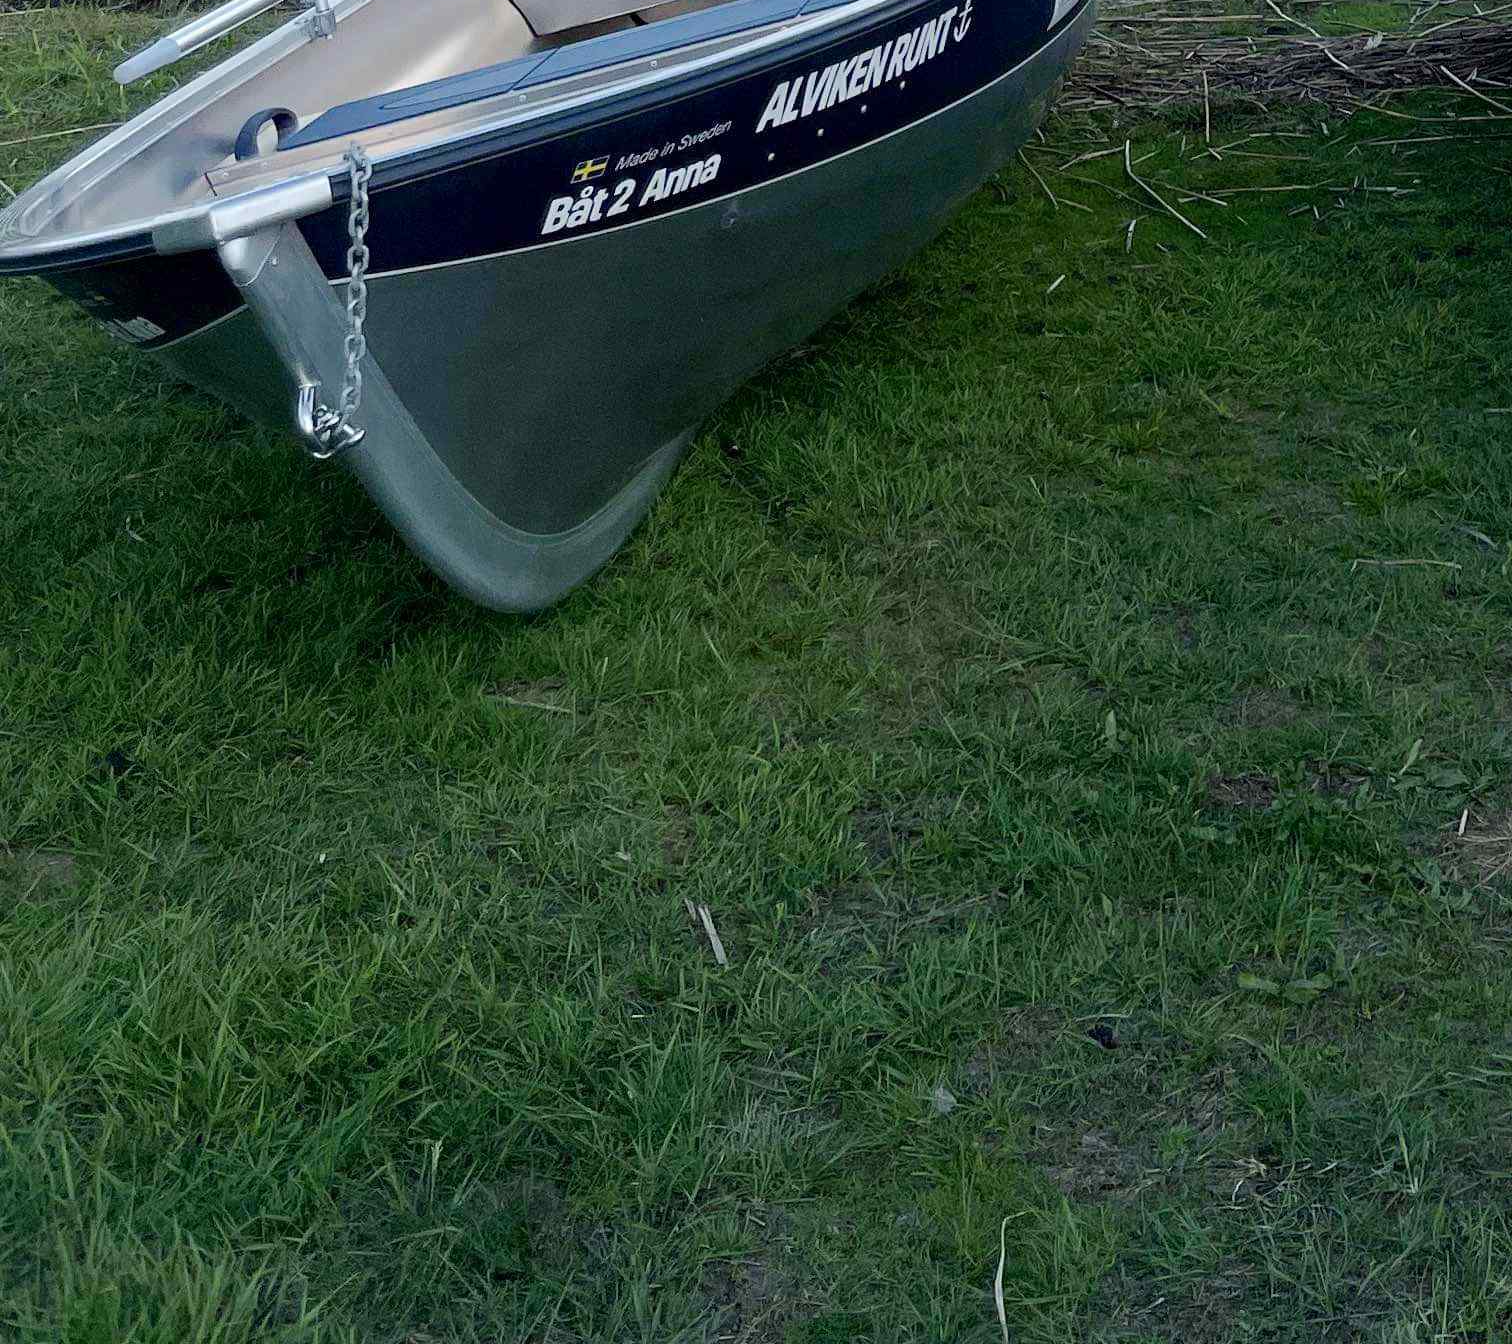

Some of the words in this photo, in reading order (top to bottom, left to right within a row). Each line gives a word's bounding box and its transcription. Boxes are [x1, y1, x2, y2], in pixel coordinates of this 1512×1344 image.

[755, 40, 892, 133] ALVIKEN
[885, 6, 957, 82] RUNT
[615, 145, 659, 171] Made
[660, 142, 674, 158] in
[678, 120, 732, 151] Sweden
[541, 186, 609, 234] Båt
[607, 178, 636, 217] 2
[639, 154, 722, 207] Anna
